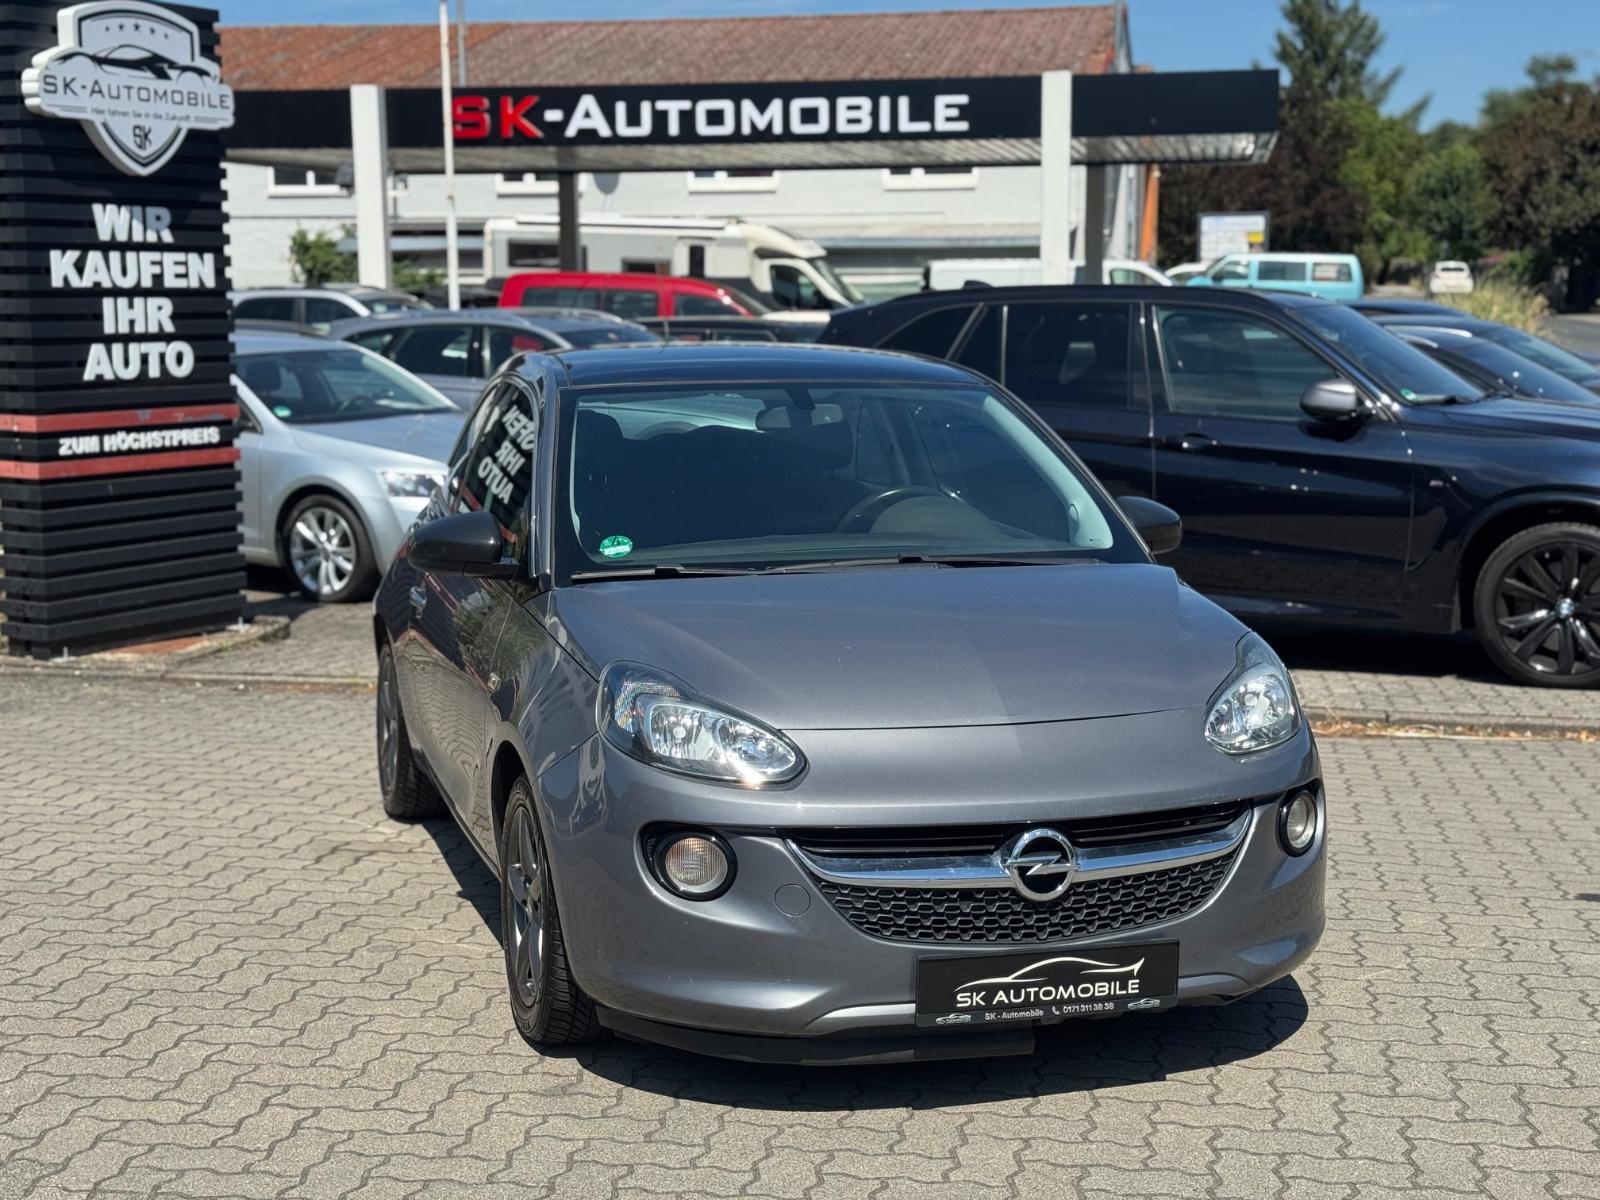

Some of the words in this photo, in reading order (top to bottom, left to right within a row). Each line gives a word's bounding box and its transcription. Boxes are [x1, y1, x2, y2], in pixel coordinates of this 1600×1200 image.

[43, 74, 230, 109] SK-AUTOMOBILE
[452, 94, 969, 138] SK-AUTOMOBILE
[92, 203, 174, 243] WIR
[50, 250, 216, 288] KAUFEN
[102, 297, 176, 334] IHR
[83, 341, 195, 381] AUTO
[58, 435, 100, 456] ZUM
[103, 426, 220, 452] HÖCHSTPREIS
[956, 991, 986, 1008] SK
[992, 979, 1140, 1005] AUTOMOBILE
[1063, 1005, 1080, 1014] 0171
[984, 1012, 997, 1021] SK
[1001, 1008, 1044, 1020] Automobile
